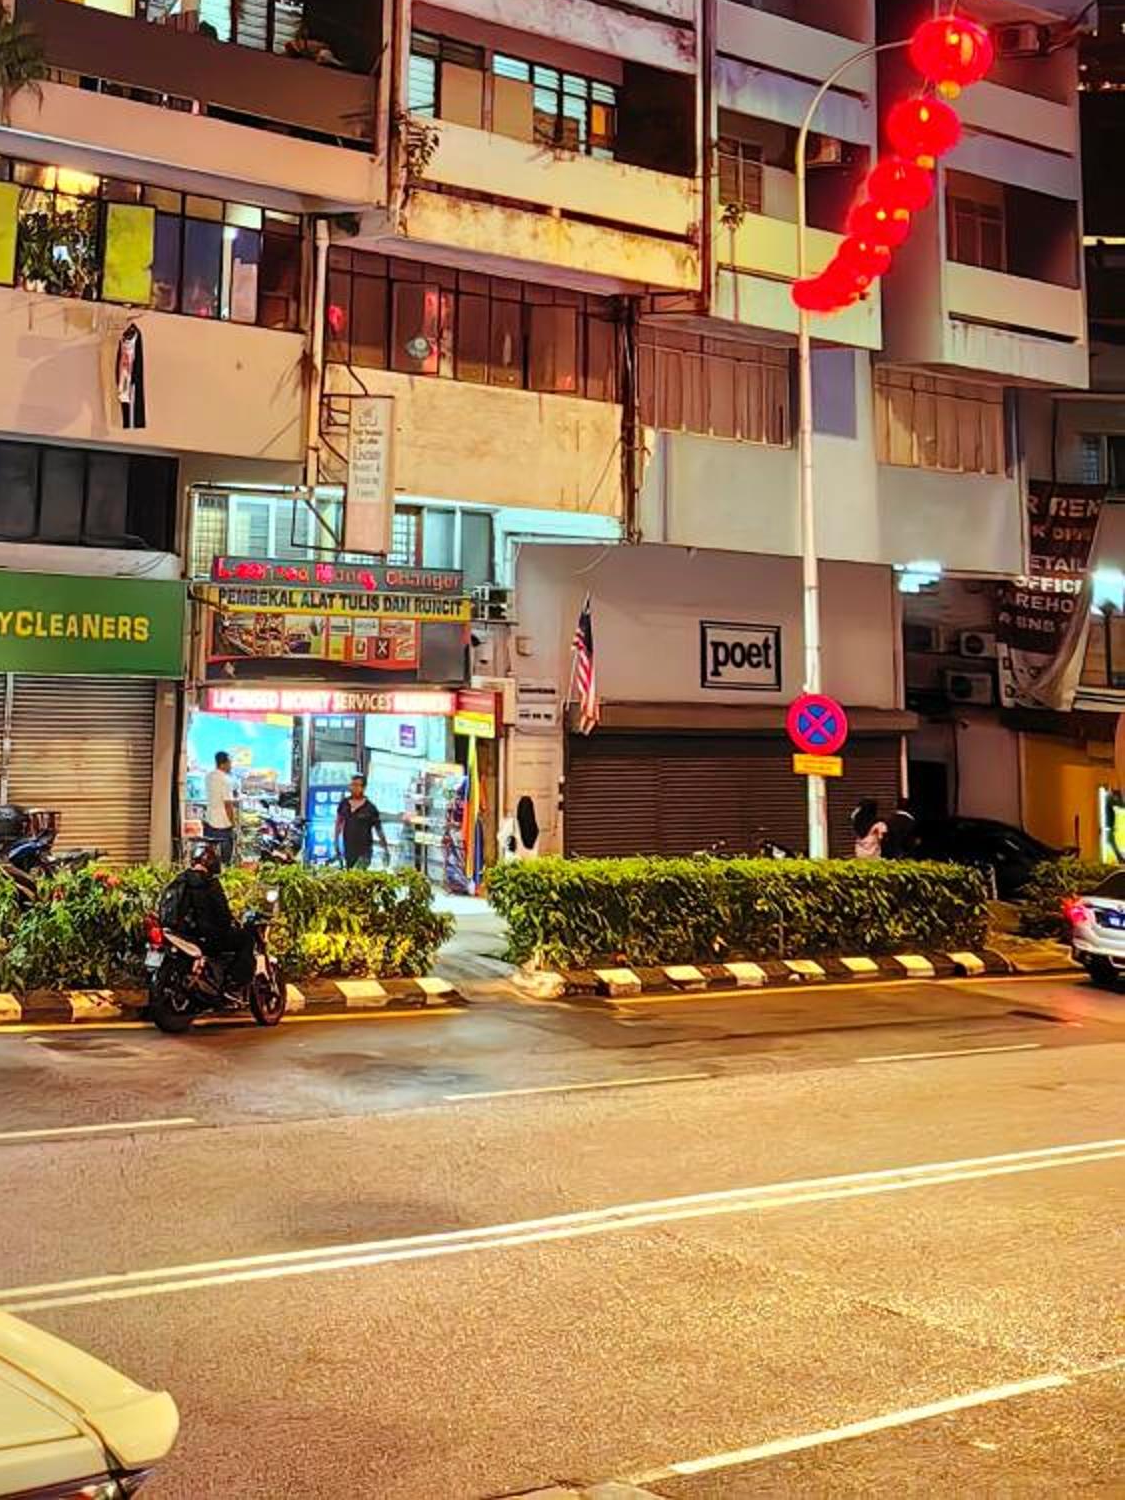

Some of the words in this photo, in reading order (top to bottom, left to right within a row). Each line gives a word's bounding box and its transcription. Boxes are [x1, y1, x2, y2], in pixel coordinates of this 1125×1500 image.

[219, 586, 295, 607] PEMBEKAL
[300, 589, 335, 609] ALAT
[340, 593, 379, 611] TULIS
[383, 595, 411, 613] DAN
[414, 596, 462, 617] RUNCIT
[709, 636, 772, 677] poet
[333, 691, 393, 711] SERVICES
